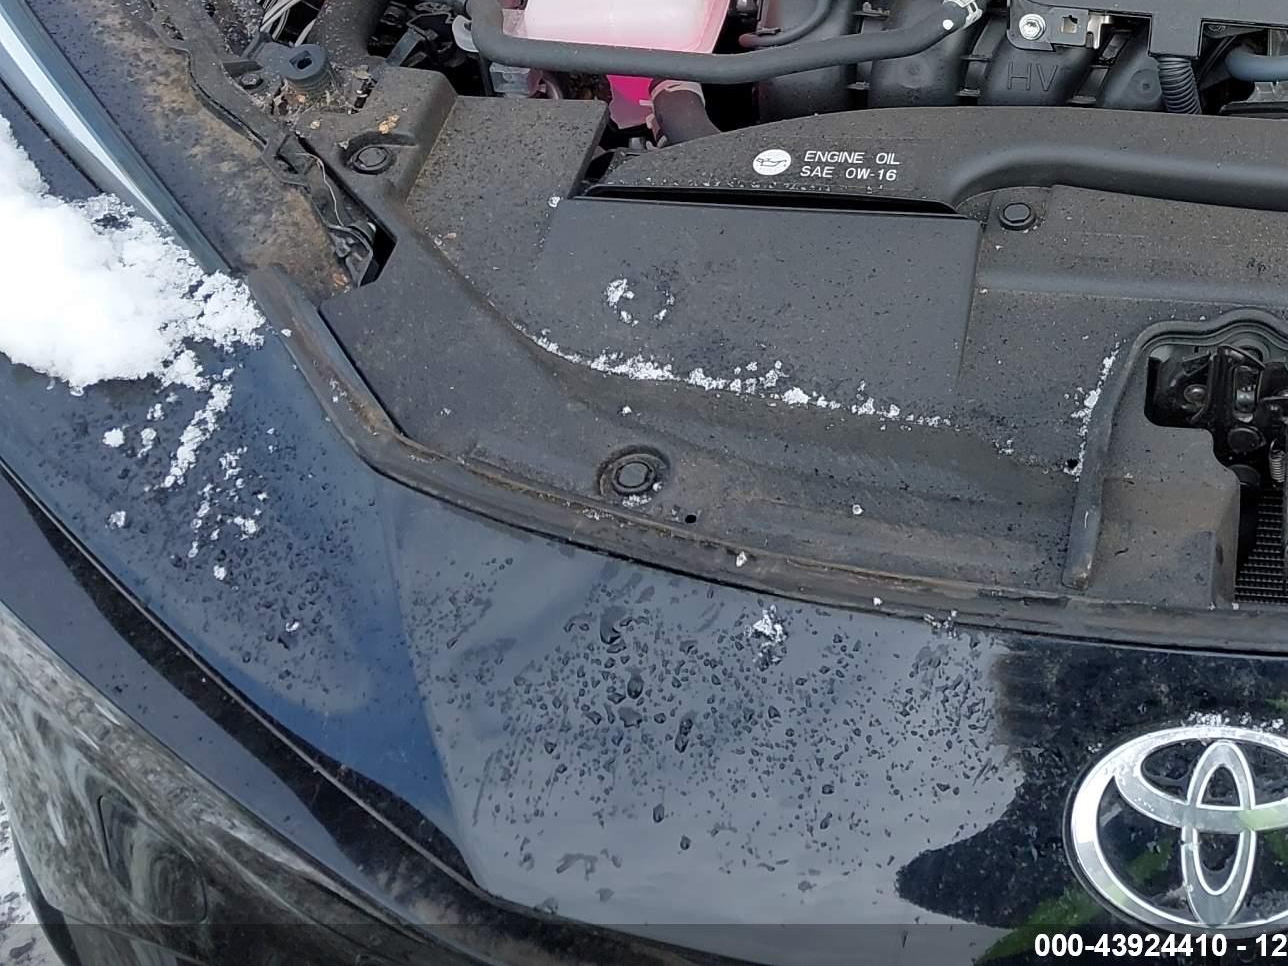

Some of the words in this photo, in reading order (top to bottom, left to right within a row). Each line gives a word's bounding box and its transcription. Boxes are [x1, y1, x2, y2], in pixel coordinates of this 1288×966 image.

[1007, 61, 1058, 91] HV
[804, 150, 865, 164] ENGINE
[875, 152, 900, 165] OIL
[800, 165, 835, 178] SAE
[845, 167, 897, 181] 0W-16
